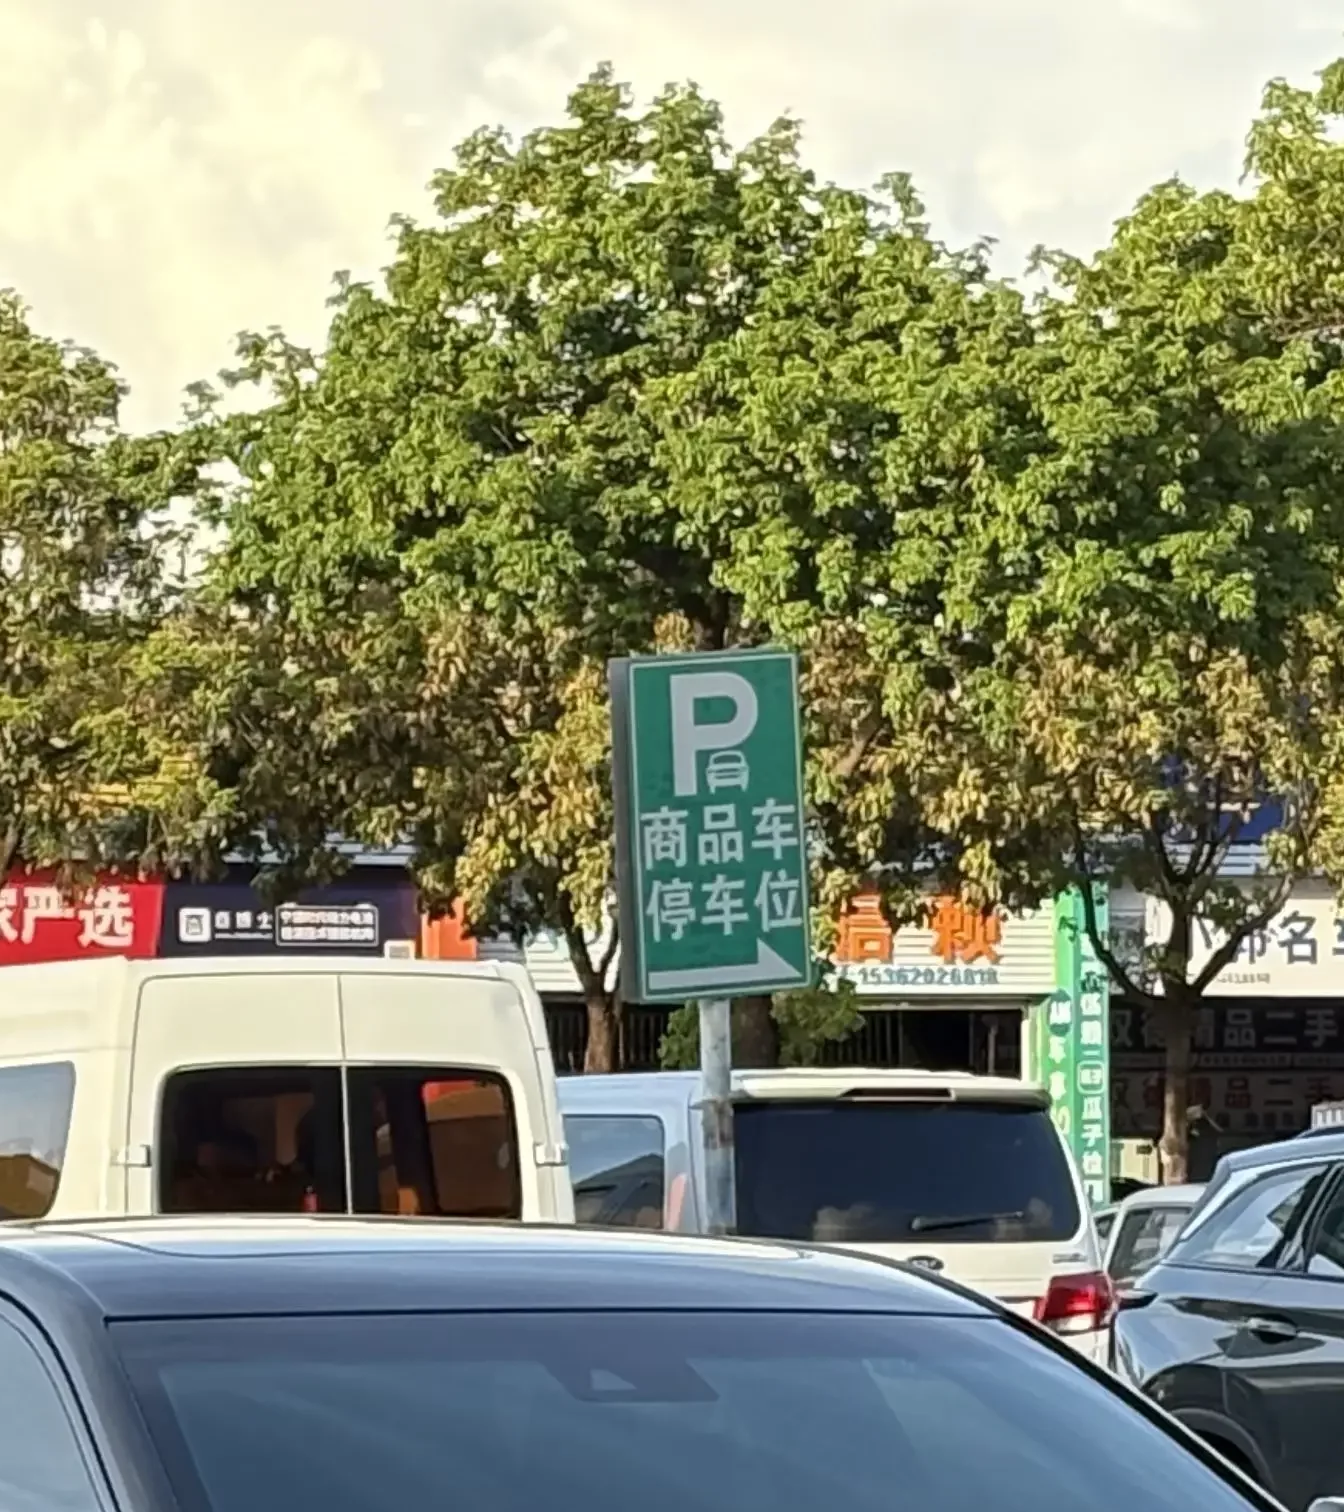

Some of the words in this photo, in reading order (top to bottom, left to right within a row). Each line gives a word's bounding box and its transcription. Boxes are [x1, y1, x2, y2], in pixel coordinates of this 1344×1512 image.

[669, 671, 758, 797] P
[641, 798, 798, 870] 商品车
[645, 868, 803, 942] 停车位
